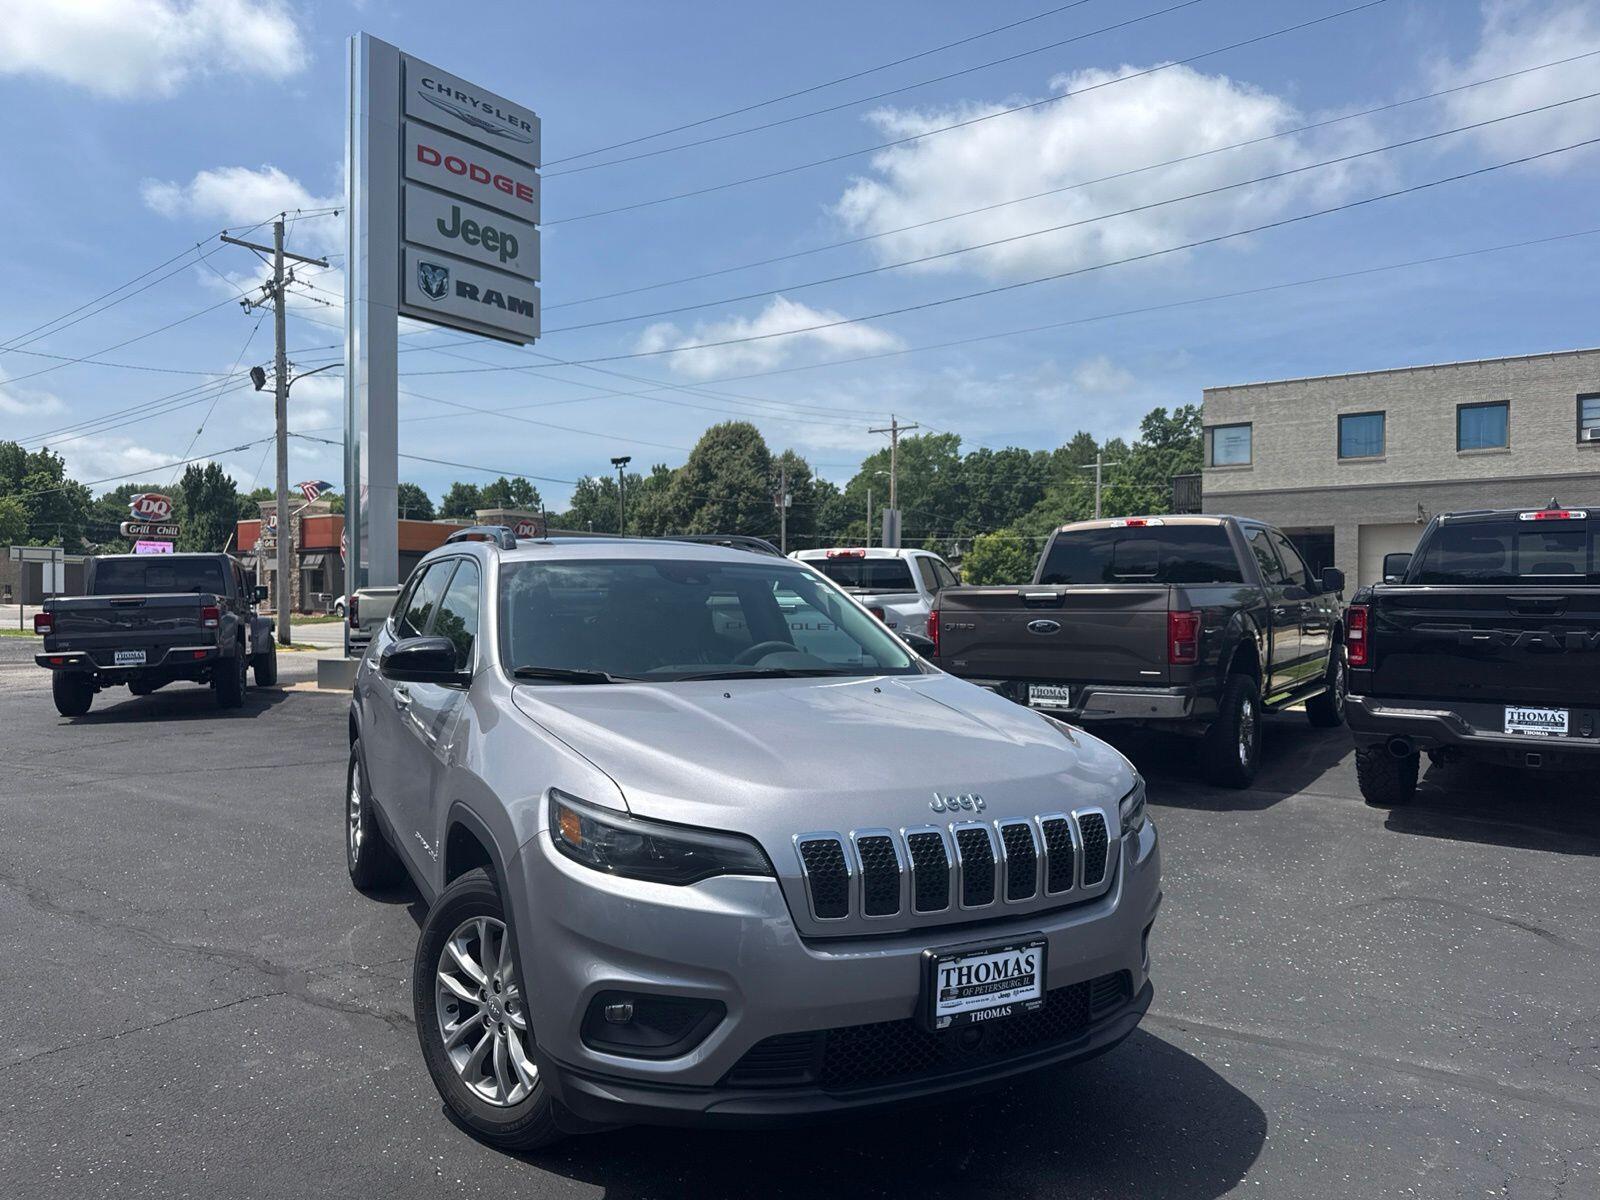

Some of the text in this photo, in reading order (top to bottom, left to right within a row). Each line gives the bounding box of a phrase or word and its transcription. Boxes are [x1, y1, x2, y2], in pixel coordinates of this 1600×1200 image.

[421, 77, 533, 134] CHRYSLER
[417, 144, 534, 204] DODGE
[436, 205, 519, 263] Jeep
[455, 279, 534, 318] RAM
[140, 499, 168, 516] DQ
[129, 525, 178, 535] Grill Chill
[519, 524, 536, 537] DQ
[1030, 687, 1068, 697] THOMAS
[1508, 711, 1565, 723] THOMAS
[928, 792, 987, 814] Jeep
[940, 954, 1035, 988] THOMAS
[962, 988, 974, 996] OF
[970, 1005, 1012, 1022] THOMAS
